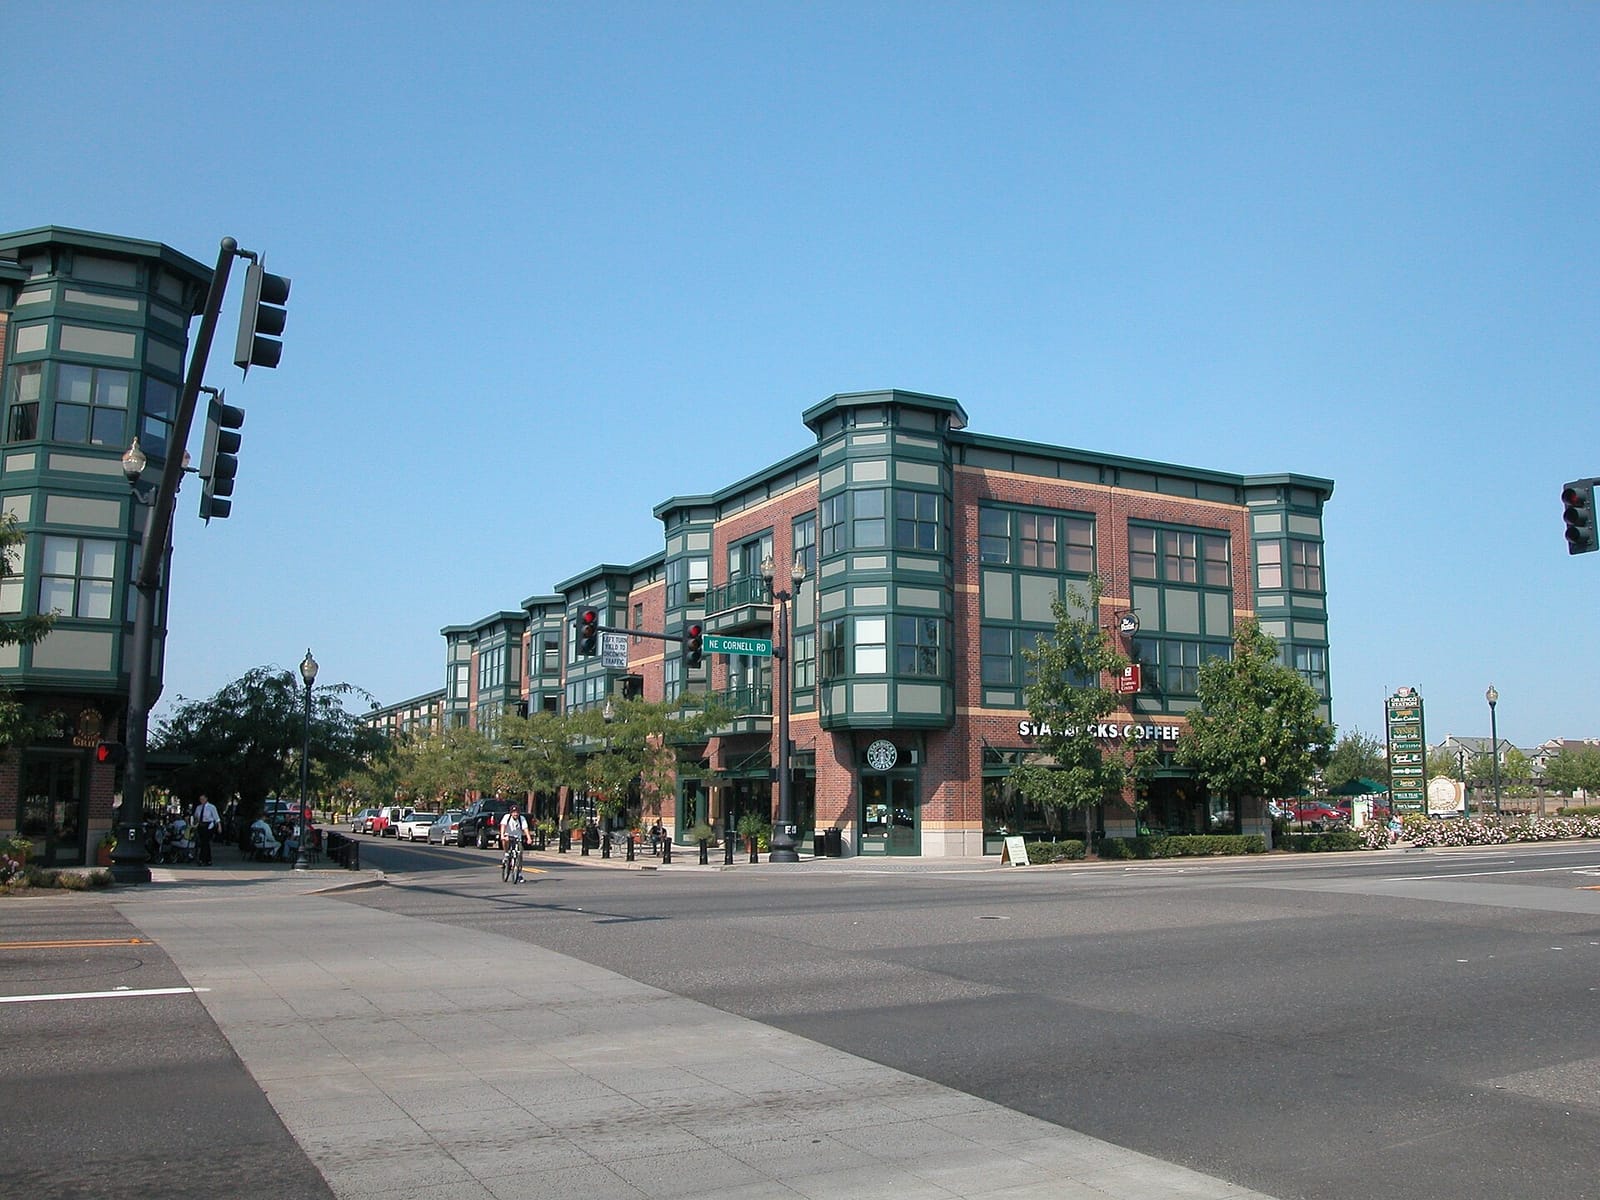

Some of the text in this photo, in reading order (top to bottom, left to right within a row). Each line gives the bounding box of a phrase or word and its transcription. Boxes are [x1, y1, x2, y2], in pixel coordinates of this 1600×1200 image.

[709, 640, 766, 652] NE CORNELL RD
